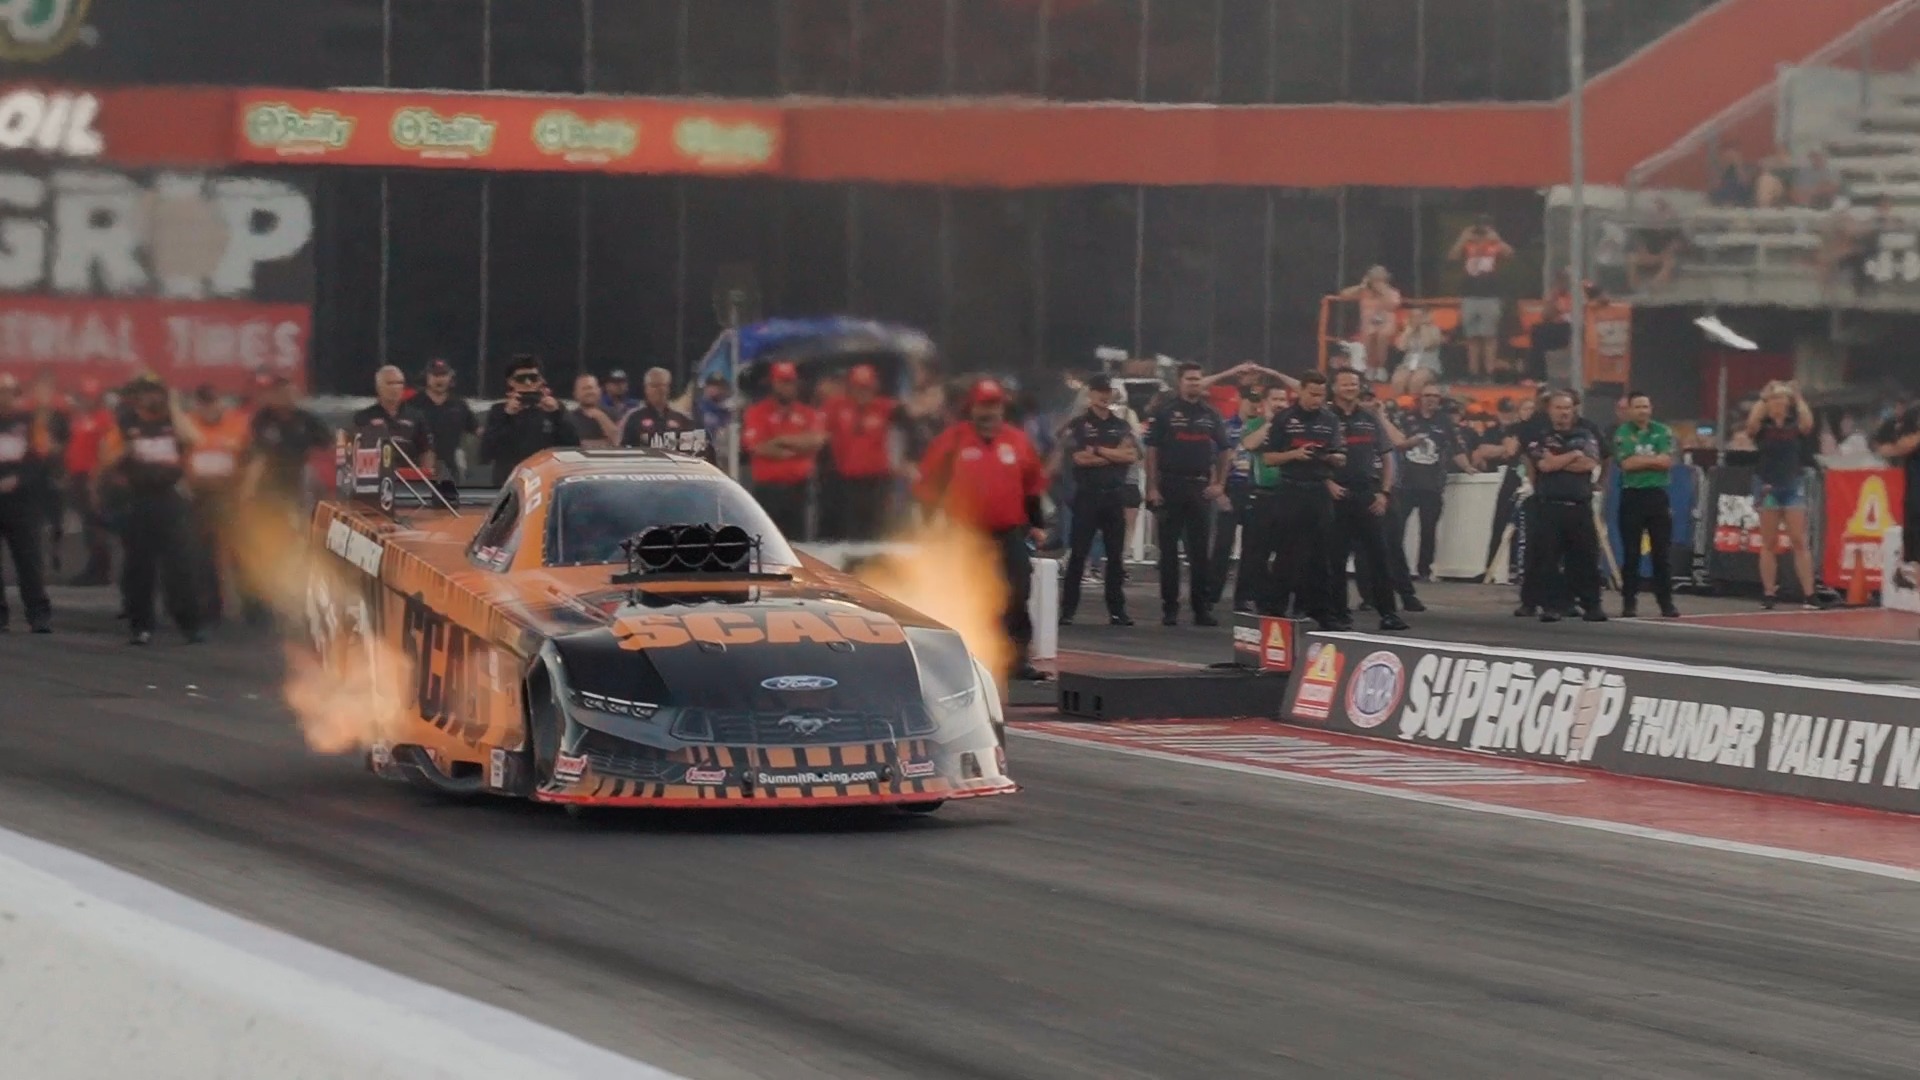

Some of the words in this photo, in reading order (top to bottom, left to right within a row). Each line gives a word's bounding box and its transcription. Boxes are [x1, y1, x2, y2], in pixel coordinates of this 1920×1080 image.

[0, 90, 104, 156] OIL
[776, 676, 823, 689] Ford
[1623, 695, 1765, 768] THUNDER
[1766, 712, 1893, 784] VALLEY
[758, 770, 878, 785] SummitRacing.com
